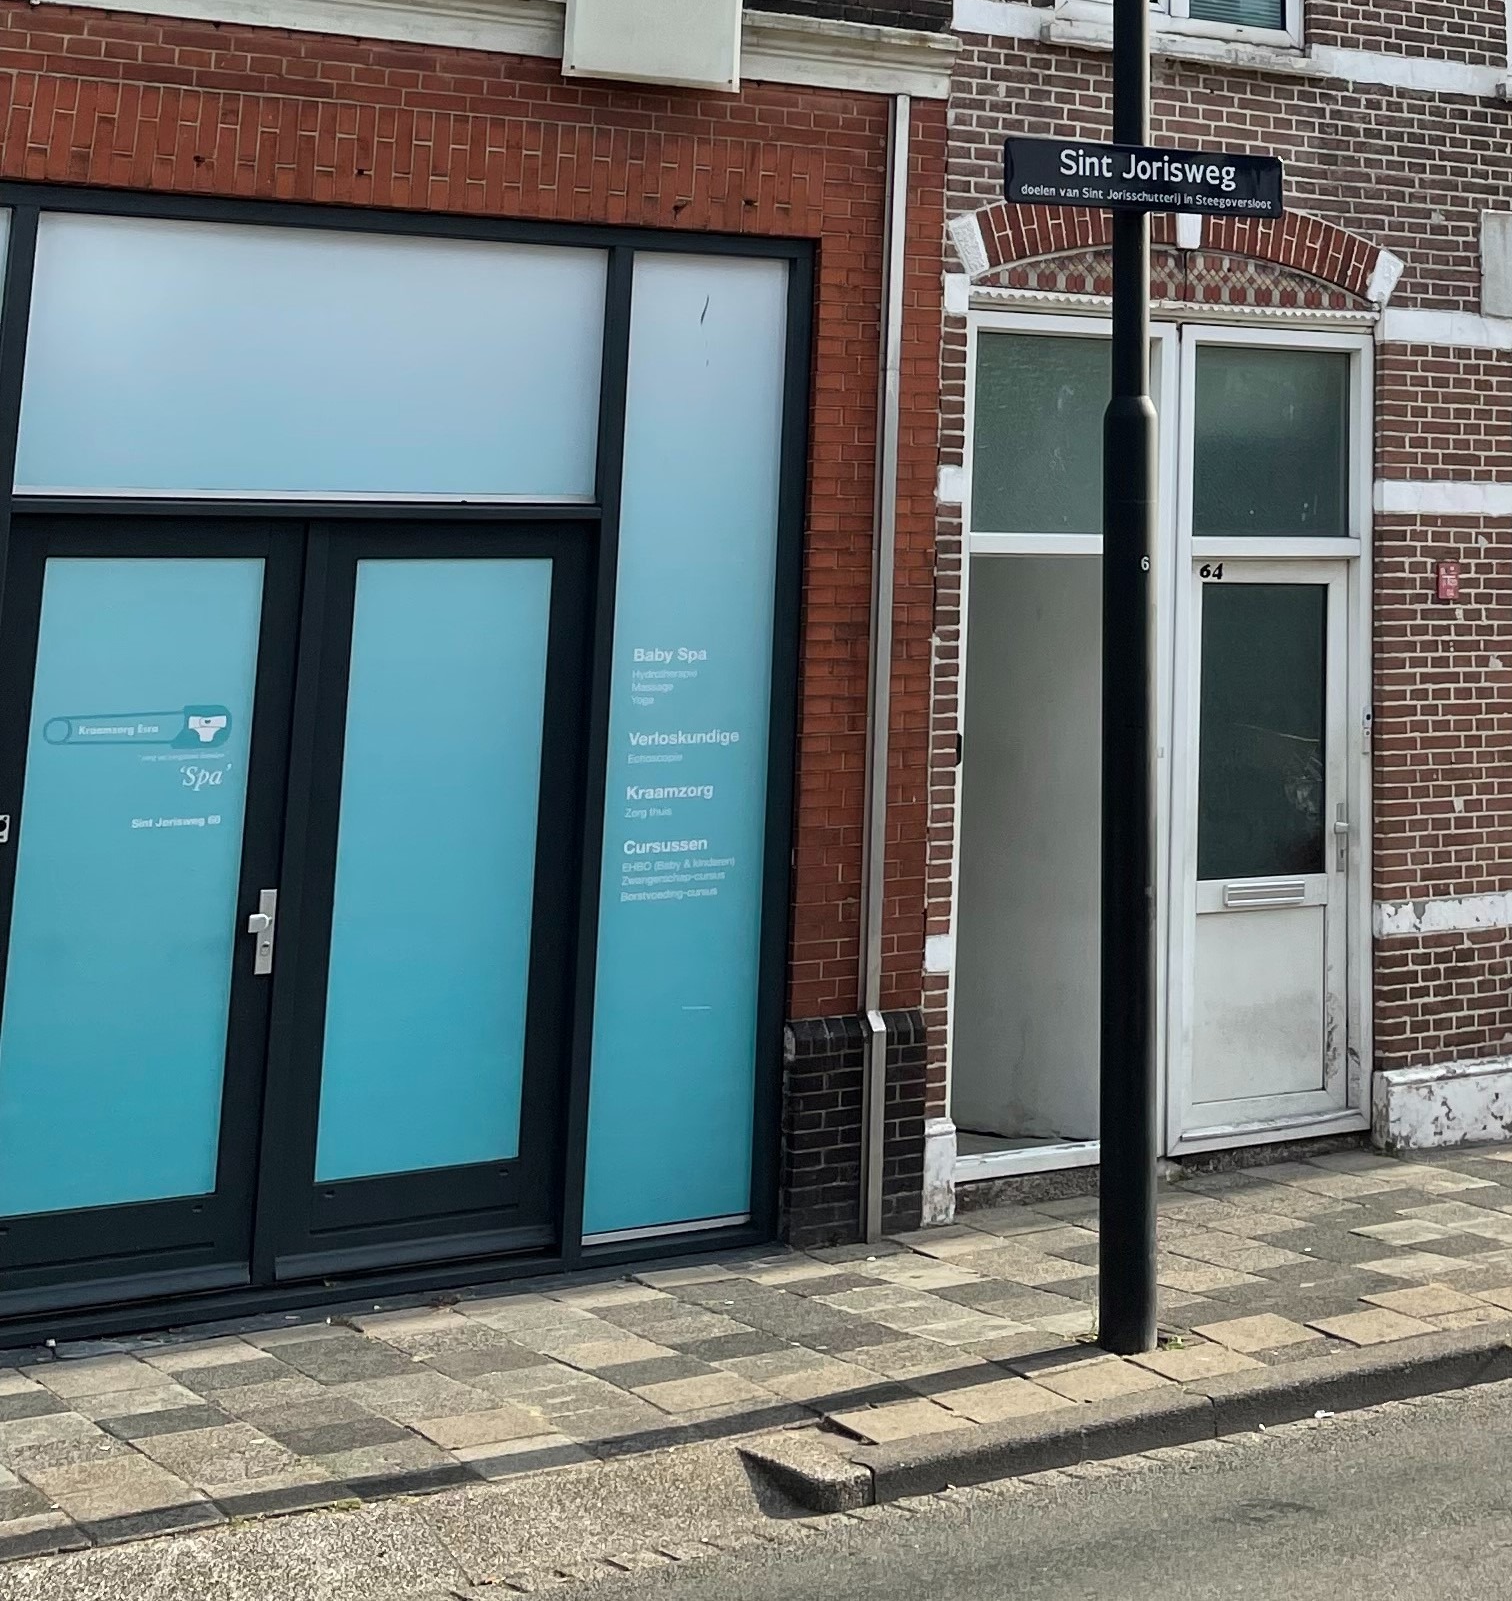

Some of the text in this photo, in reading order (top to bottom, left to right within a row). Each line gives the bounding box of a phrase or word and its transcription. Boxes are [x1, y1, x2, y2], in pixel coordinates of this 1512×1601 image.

[1060, 149, 1236, 191] Sint Jorisweg
[1021, 184, 1272, 210] doelen van Sint Jorisschutterij in Steegoversloot
[1140, 556, 1150, 571] 6
[1200, 563, 1224, 580] 64
[633, 647, 707, 664] Baby Spa
[629, 729, 740, 746] Verloskundige
[626, 784, 714, 800] Kraamzorg
[624, 806, 672, 819] Zorg thuis
[131, 817, 153, 829] Sint
[155, 816, 205, 829] Jorisweg
[623, 837, 708, 855] Cursussen
[622, 862, 652, 873] EHBO
[683, 858, 692, 869] &
